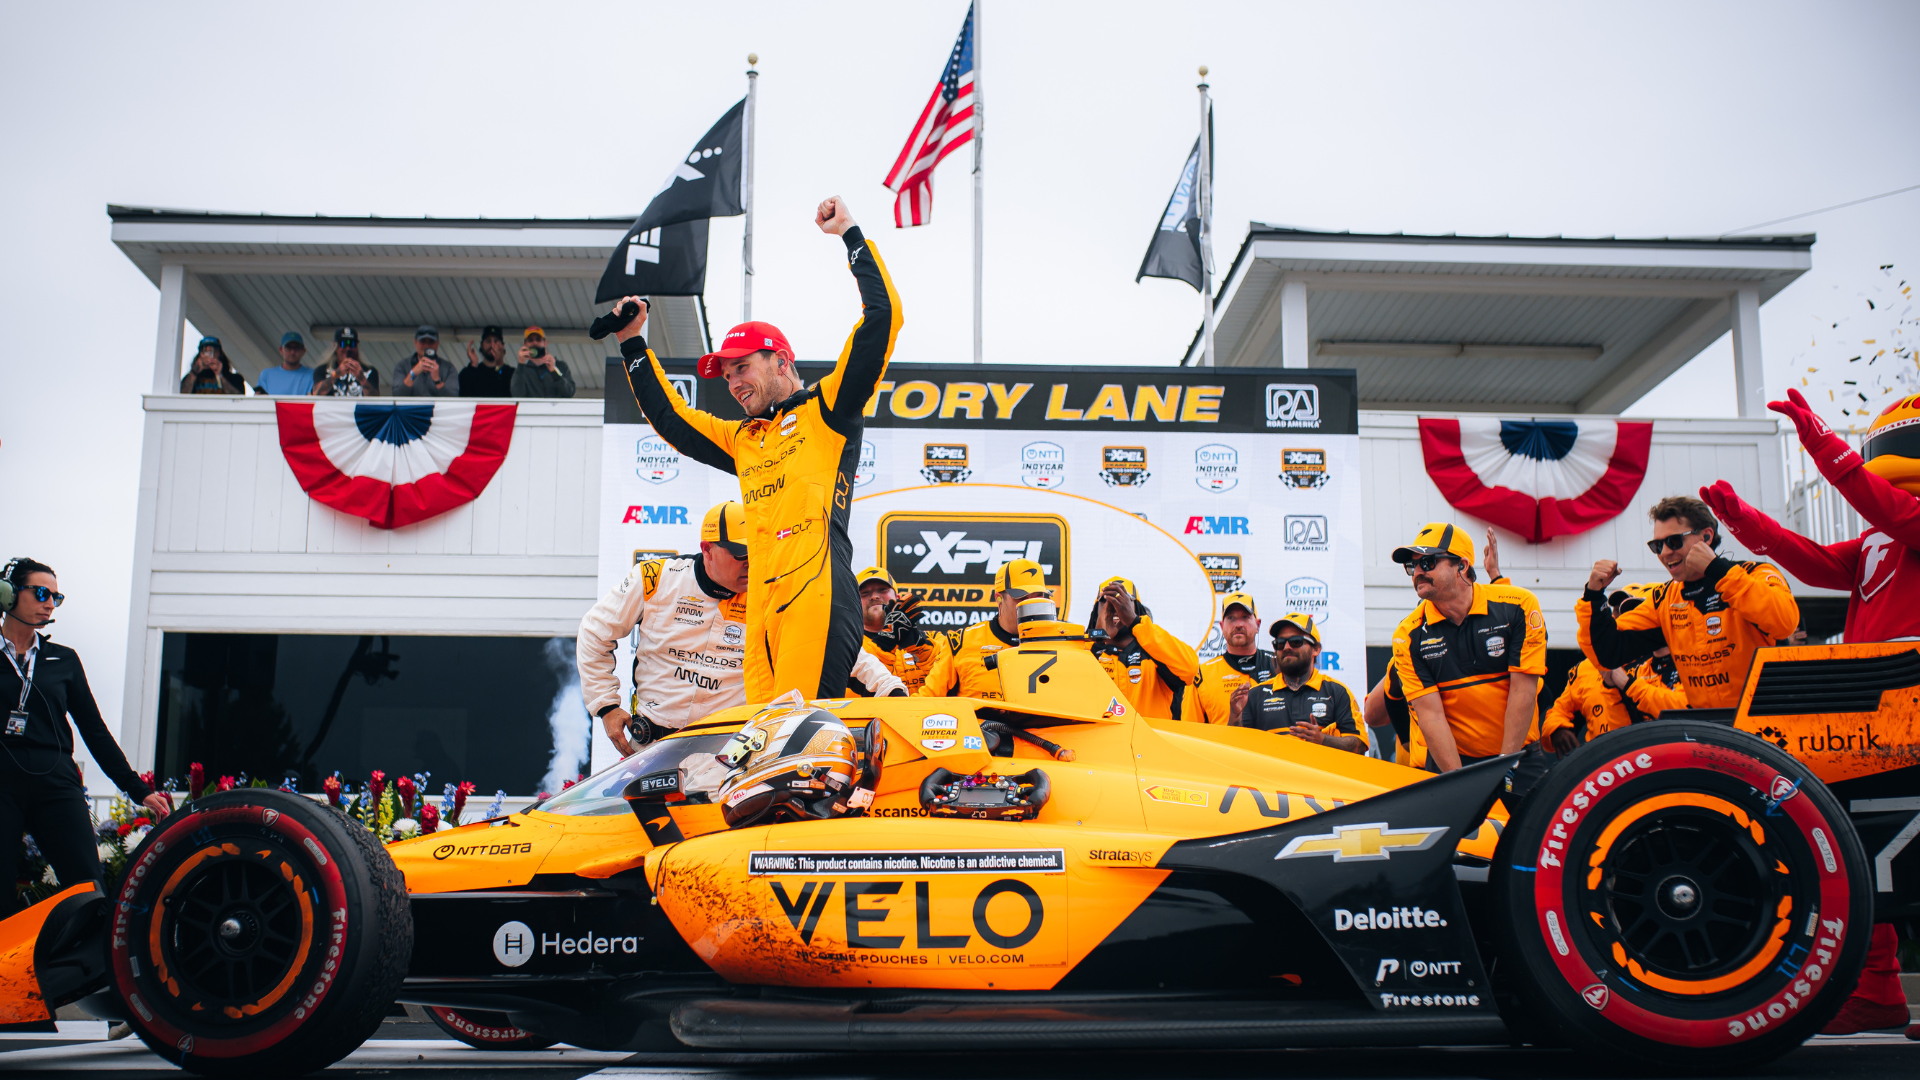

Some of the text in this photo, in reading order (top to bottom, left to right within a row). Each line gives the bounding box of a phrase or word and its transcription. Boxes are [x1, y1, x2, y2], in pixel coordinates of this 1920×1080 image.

[864, 380, 1224, 423] TORY LANE
[1266, 420, 1320, 429] ROAD AMERICA
[637, 456, 679, 464] INDYCAR
[932, 446, 966, 459] XPEL
[1039, 450, 1059, 459] NTT
[1109, 449, 1144, 462] XPEL
[1212, 453, 1233, 461] NTT
[1290, 451, 1323, 465] XPEL
[740, 445, 797, 478] REYNOLDS
[1196, 465, 1237, 473] INDYCAR
[834, 471, 850, 510] CL7
[622, 505, 690, 525] AMR
[791, 520, 813, 535] CL7
[1184, 516, 1250, 535] AMR
[911, 530, 1054, 575] XPEL
[1205, 555, 1239, 569] XPEL
[1286, 599, 1328, 607] INDYCAR
[918, 610, 966, 625] ROAD
[668, 647, 738, 668] REYNOLDS
[1674, 648, 1731, 663] REYNOLDS
[674, 666, 723, 690] ARROW
[1018, 650, 1057, 693] 7
[901, 677, 925, 685] OLDS
[1688, 671, 1730, 688] ARROW
[935, 719, 955, 727] NTT
[963, 737, 982, 749] PPG
[1799, 724, 1880, 751] rubrik
[649, 777, 676, 789] VELO
[733, 793, 745, 801] BELL
[1540, 753, 1653, 869] Firestone
[457, 845, 489, 855] NTT
[1089, 849, 1152, 863] stratasys
[754, 855, 1057, 872] WARNING: This product contains nicotine. Nicotine is an addictive chemical.
[113, 841, 166, 949] Firestone
[768, 879, 1044, 949] VELO
[1334, 907, 1447, 931] Deloitte.
[542, 931, 638, 955] Hedera
[294, 907, 346, 1019] Firestone
[796, 950, 928, 965] NICOTINE POUCHES
[949, 954, 1024, 964] VELO.COM
[1429, 961, 1462, 975] NTT
[1728, 917, 1845, 1038] Firestone
[1380, 992, 1480, 1008] Firestone
[446, 1012, 527, 1039] Firestone
